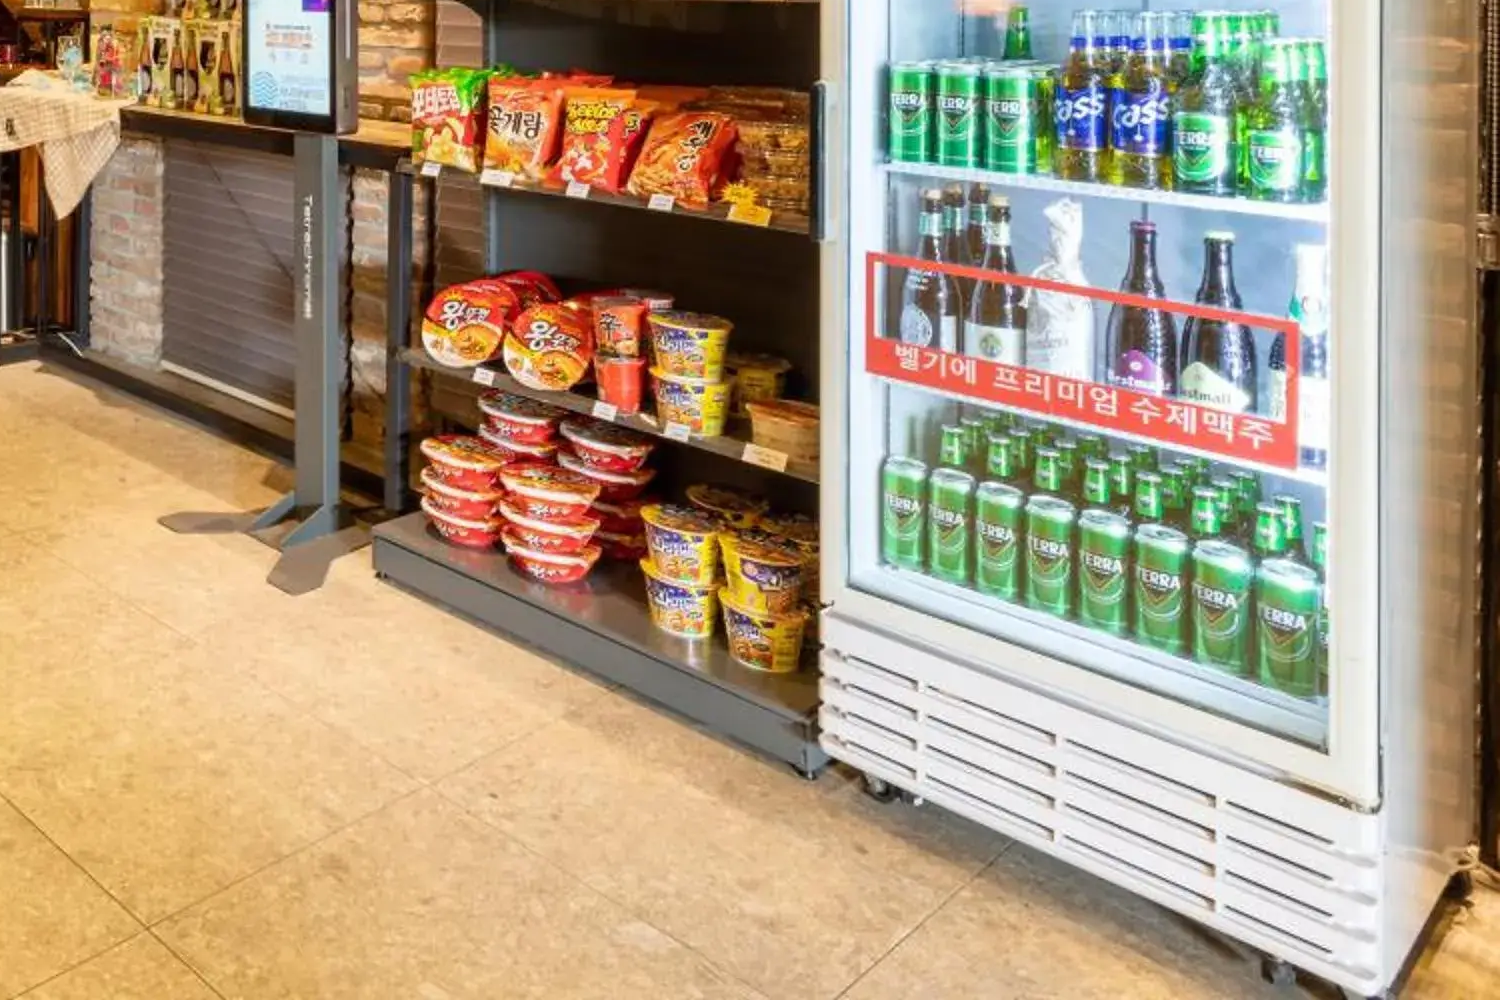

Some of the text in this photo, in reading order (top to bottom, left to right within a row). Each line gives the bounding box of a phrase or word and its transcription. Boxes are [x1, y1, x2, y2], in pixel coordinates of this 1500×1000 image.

[489, 104, 543, 140] 꽃게랑
[895, 344, 978, 385] 벨기에
[993, 366, 1119, 417] 프리미엄
[1129, 396, 1275, 449] 수제맥주
[1030, 536, 1070, 558] TERRA
[1079, 549, 1123, 575] TERRA
[1138, 566, 1182, 592] TERRA
[1192, 581, 1239, 609] TERRA
